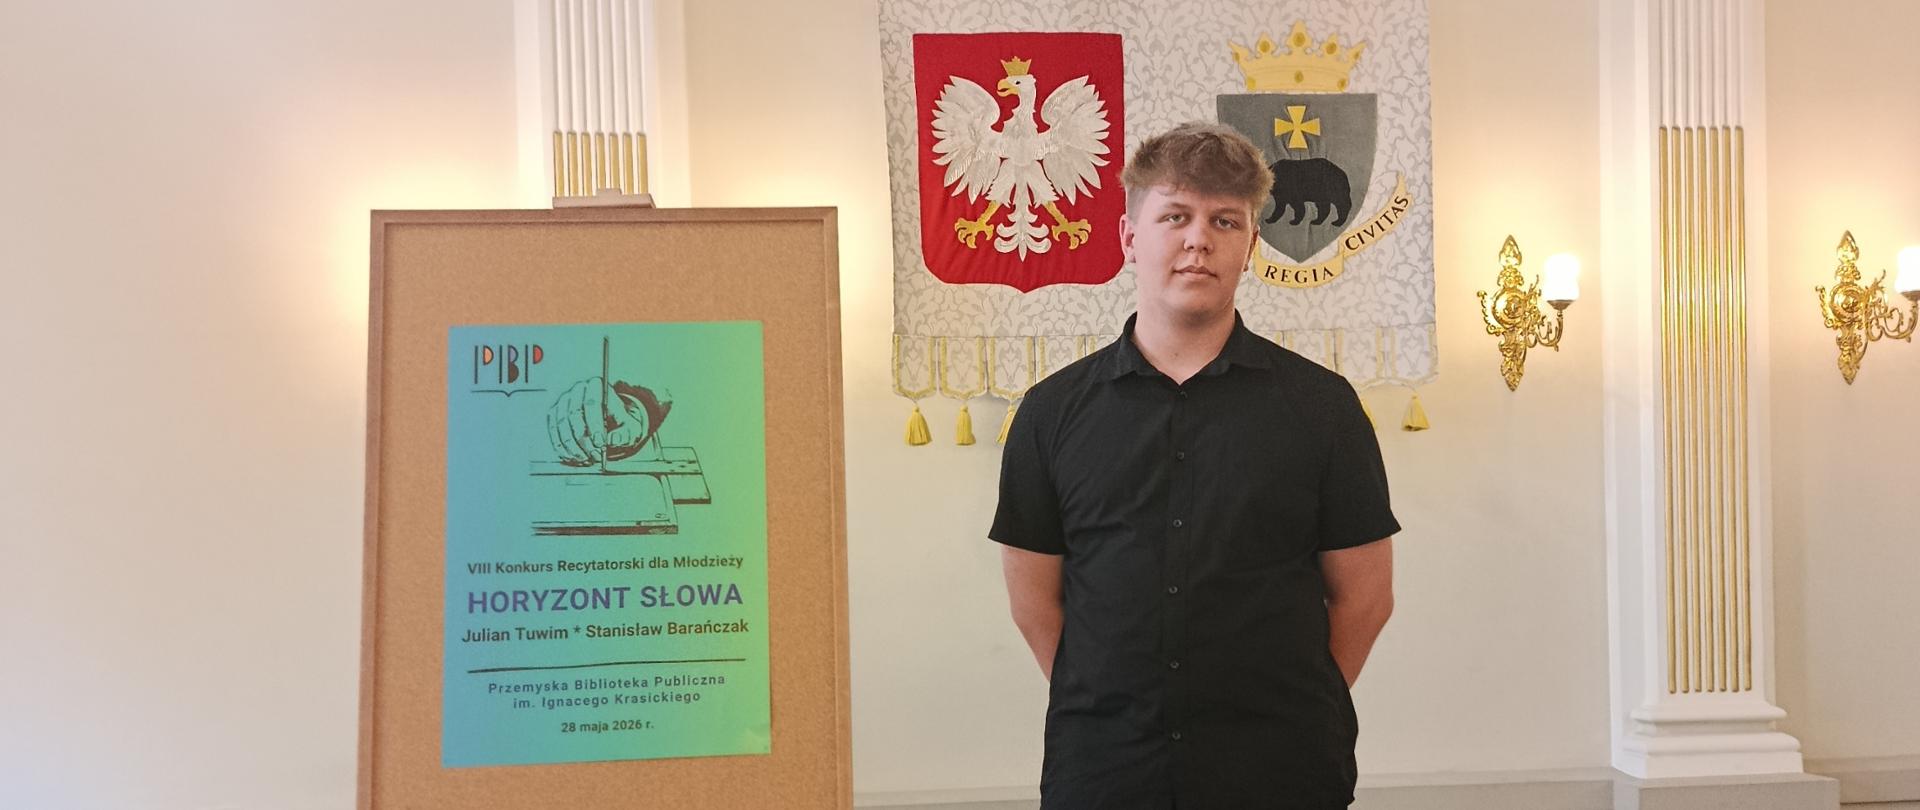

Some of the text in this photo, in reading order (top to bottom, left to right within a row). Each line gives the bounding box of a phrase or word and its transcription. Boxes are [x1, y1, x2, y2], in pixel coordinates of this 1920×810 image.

[1264, 196, 1409, 283] REGIA CIVITAS
[468, 555, 744, 574] VIII Konkurs Recytatorski dla Młodzieży
[468, 583, 743, 614] HORYZONT SŁOWA
[462, 628, 510, 643] Julian
[515, 626, 569, 641] Tuwim
[586, 623, 662, 638] Stanisław
[667, 619, 749, 635] Barańczak
[489, 675, 725, 694] Przemyska Biblioteka Publiczna
[513, 691, 701, 710] im. Ignacego Krasickiego
[561, 720, 654, 734] 28 maja 2026 r.
